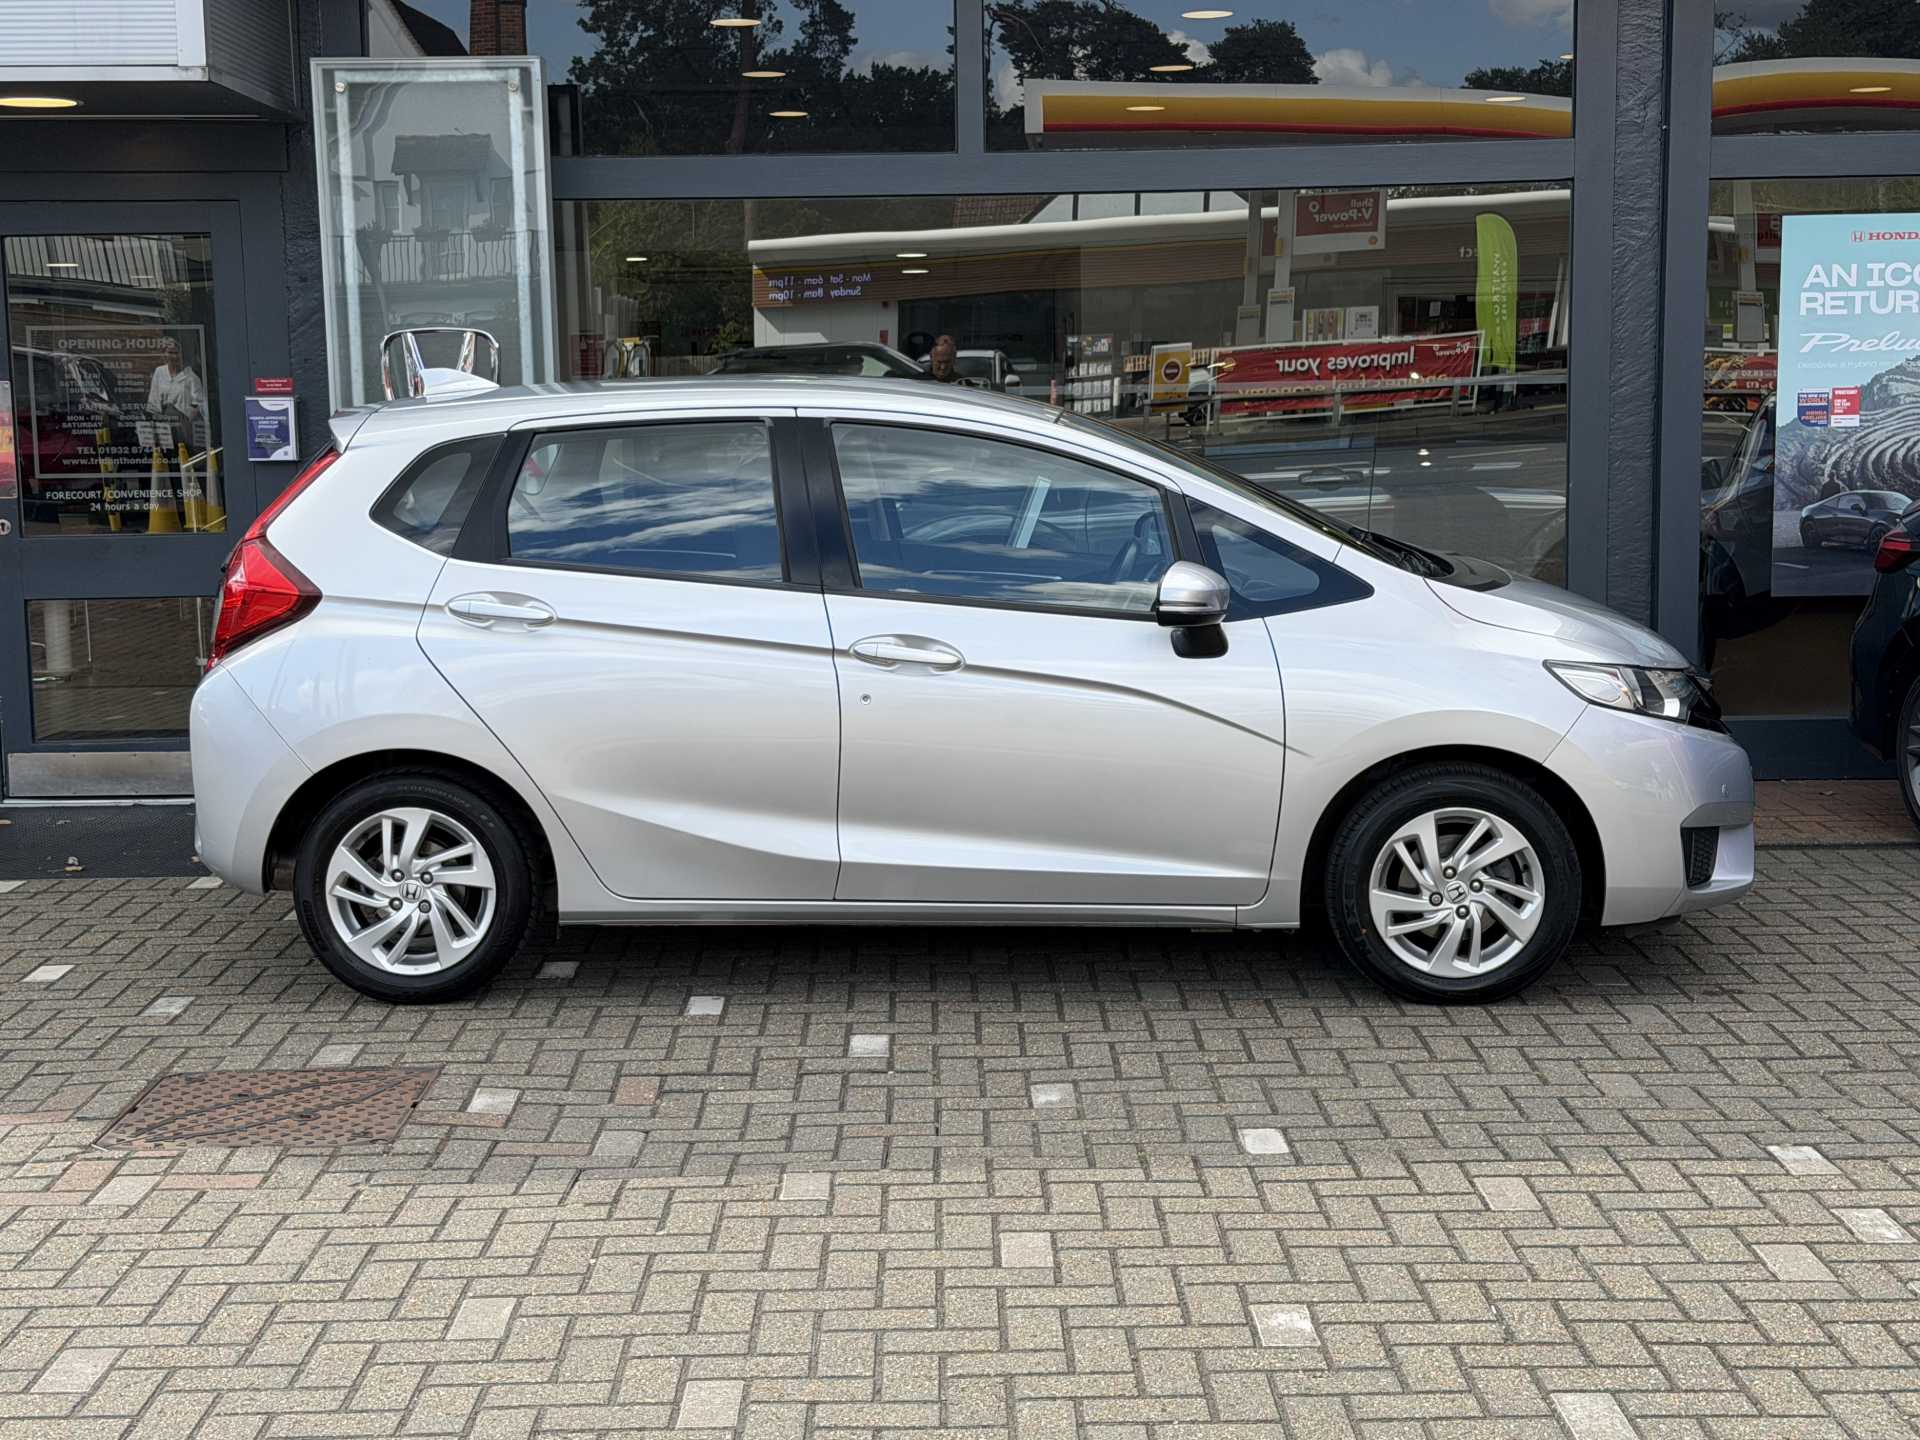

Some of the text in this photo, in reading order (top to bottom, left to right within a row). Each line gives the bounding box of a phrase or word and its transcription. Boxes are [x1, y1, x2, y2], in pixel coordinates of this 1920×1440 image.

[1868, 232, 1920, 240] HOND
[1802, 262, 1920, 288] AN IC
[1799, 290, 1919, 316] RETUR
[58, 339, 122, 350] OPENING
[76, 447, 96, 455] TEL
[46, 490, 101, 500] FORECOURT
[176, 488, 202, 498] SHOP
[89, 502, 101, 512] 24
[104, 502, 131, 512] hours
[143, 502, 160, 512] day
